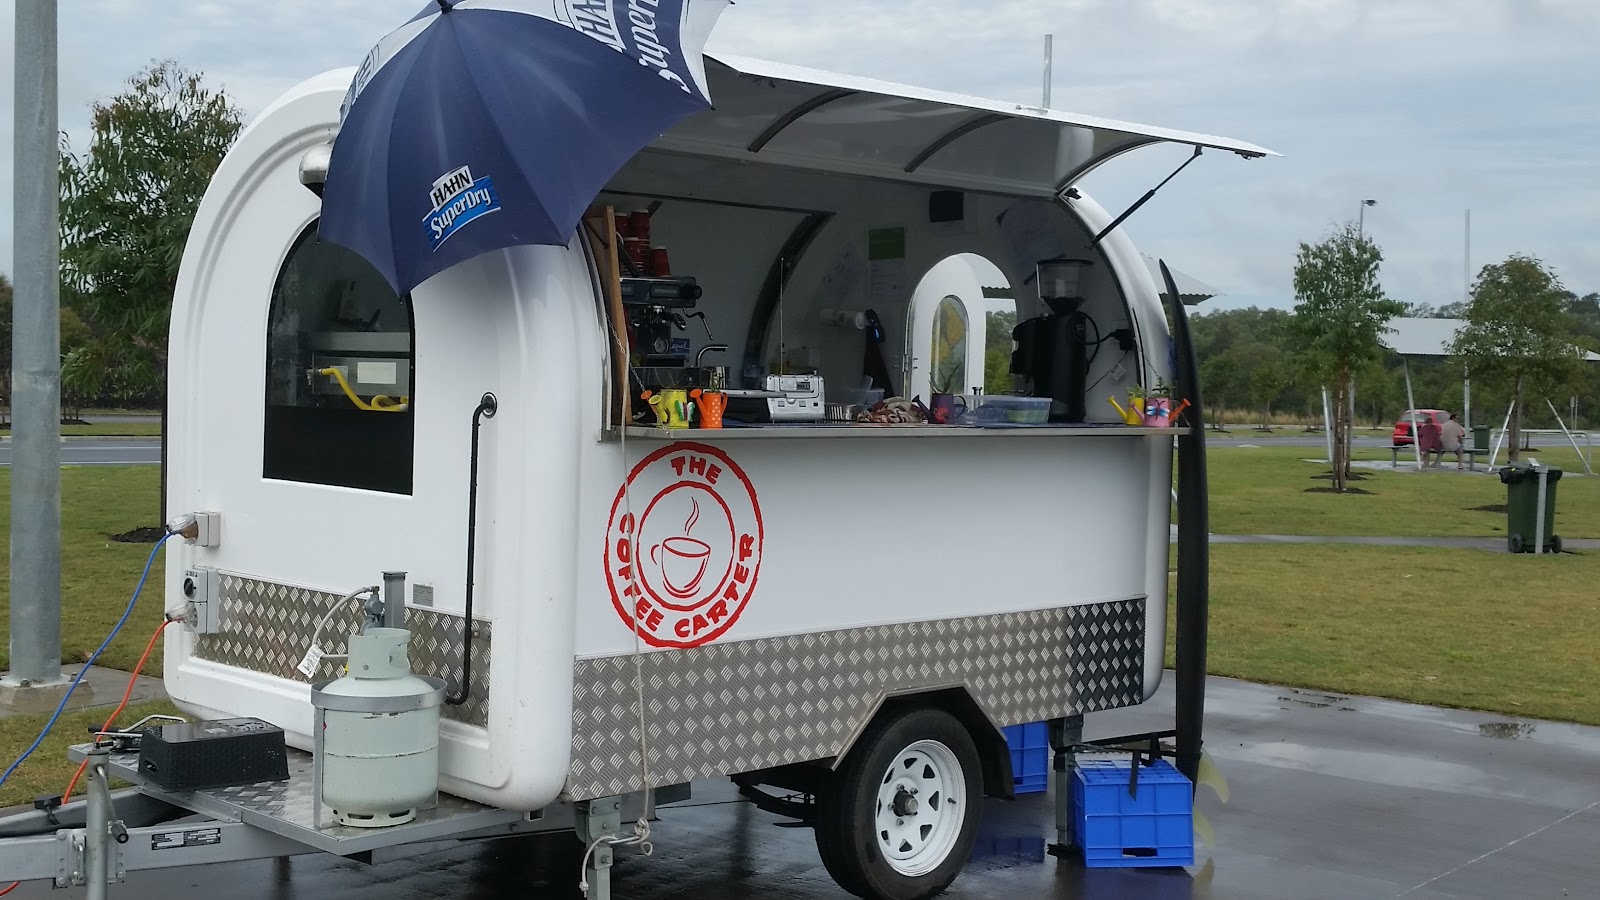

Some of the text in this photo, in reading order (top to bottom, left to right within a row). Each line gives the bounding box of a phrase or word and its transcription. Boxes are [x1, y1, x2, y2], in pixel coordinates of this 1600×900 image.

[432, 169, 471, 207] HAHN
[430, 187, 492, 240] SuperDry
[670, 456, 722, 485] THE
[616, 512, 755, 639] COFFEE CARTER
